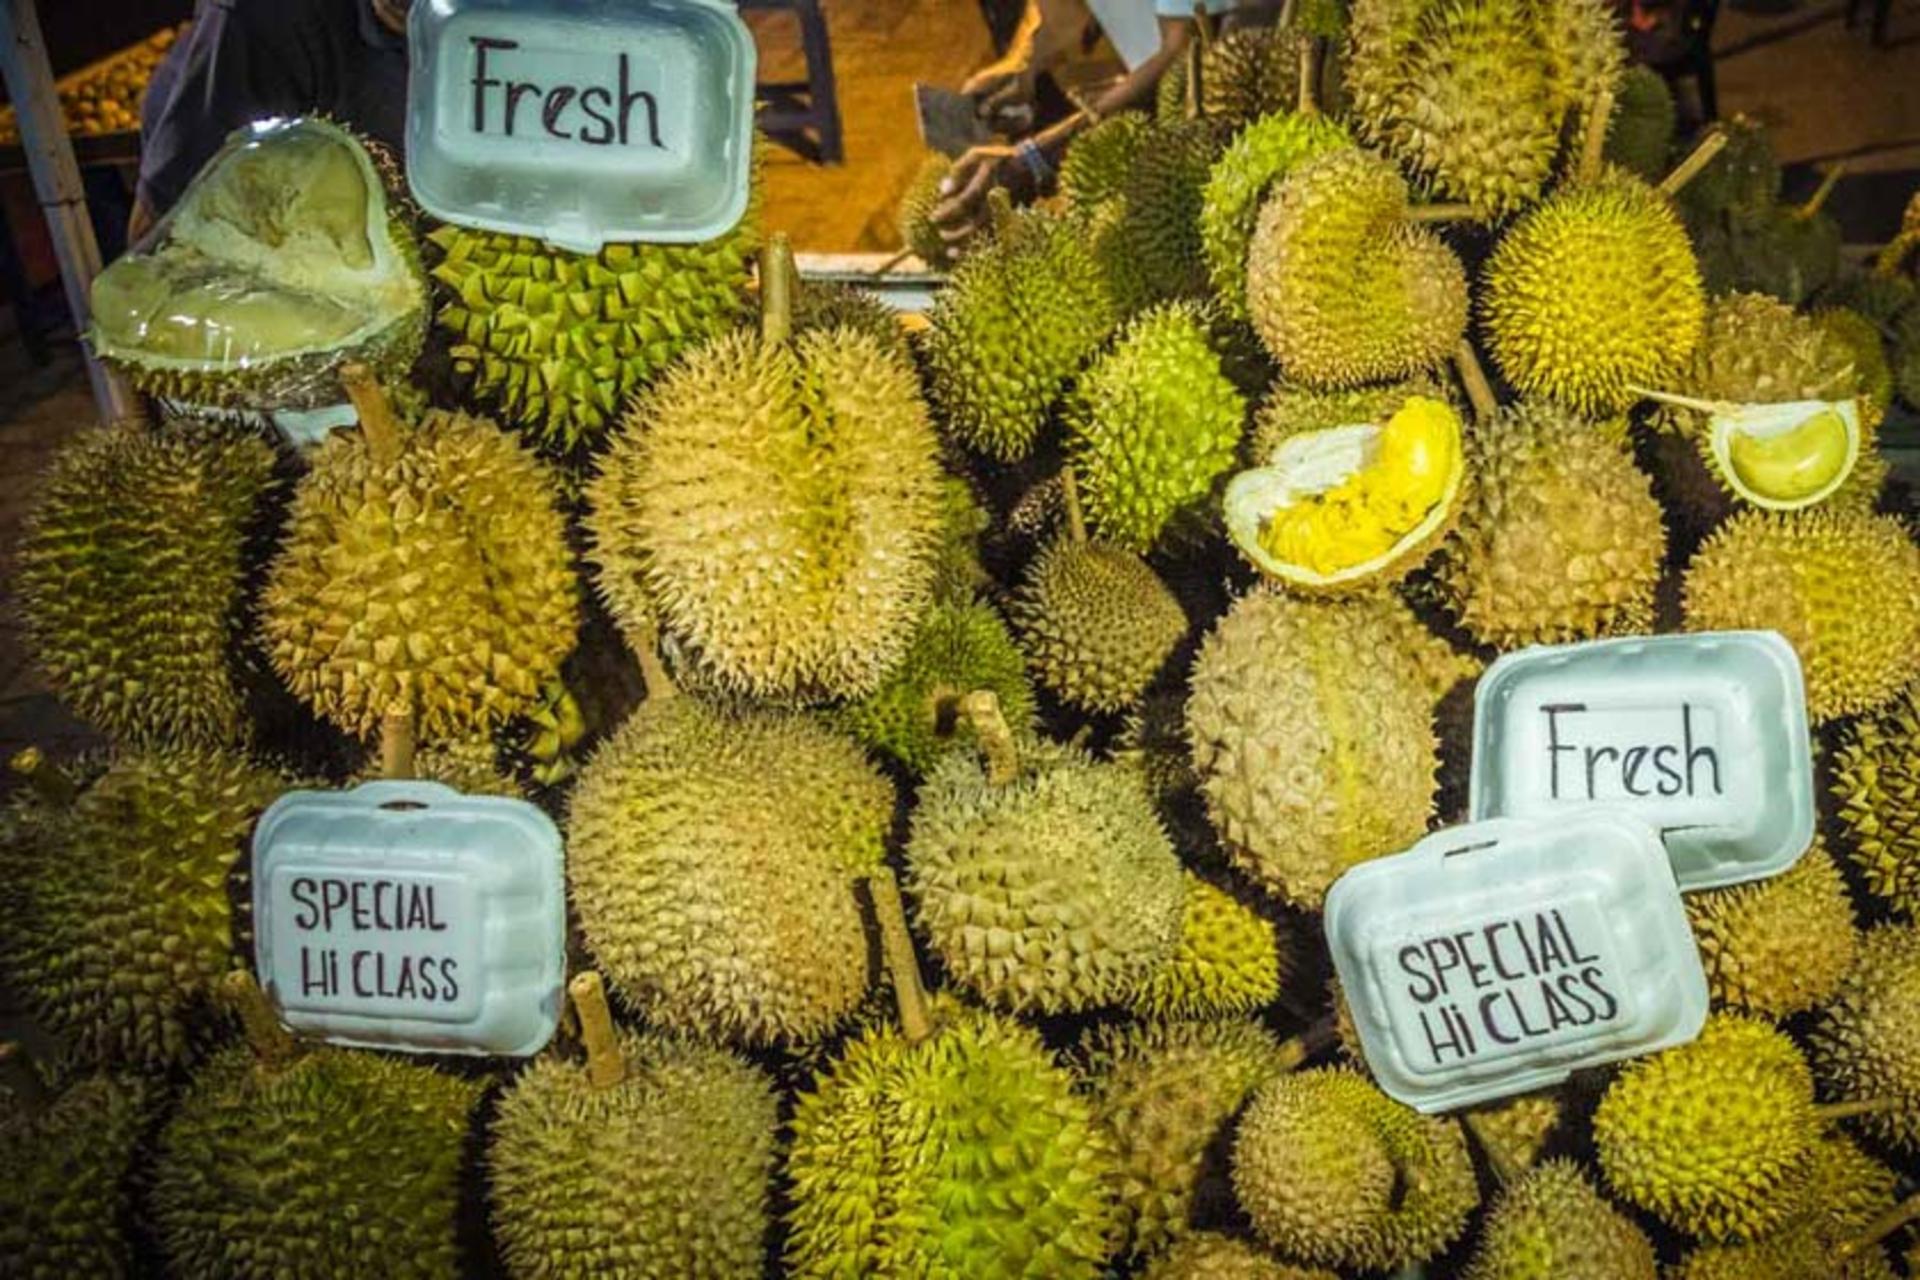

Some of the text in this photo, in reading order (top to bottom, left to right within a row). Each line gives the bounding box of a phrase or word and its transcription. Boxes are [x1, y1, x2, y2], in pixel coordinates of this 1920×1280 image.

[467, 34, 670, 149] Fresh
[1540, 703, 1722, 799] Fresh
[290, 876, 448, 932] SPECIAL
[352, 949, 460, 1003] CLASS
[1398, 908, 1601, 1004] SPECIAL
[1480, 966, 1619, 1046] CLASS
